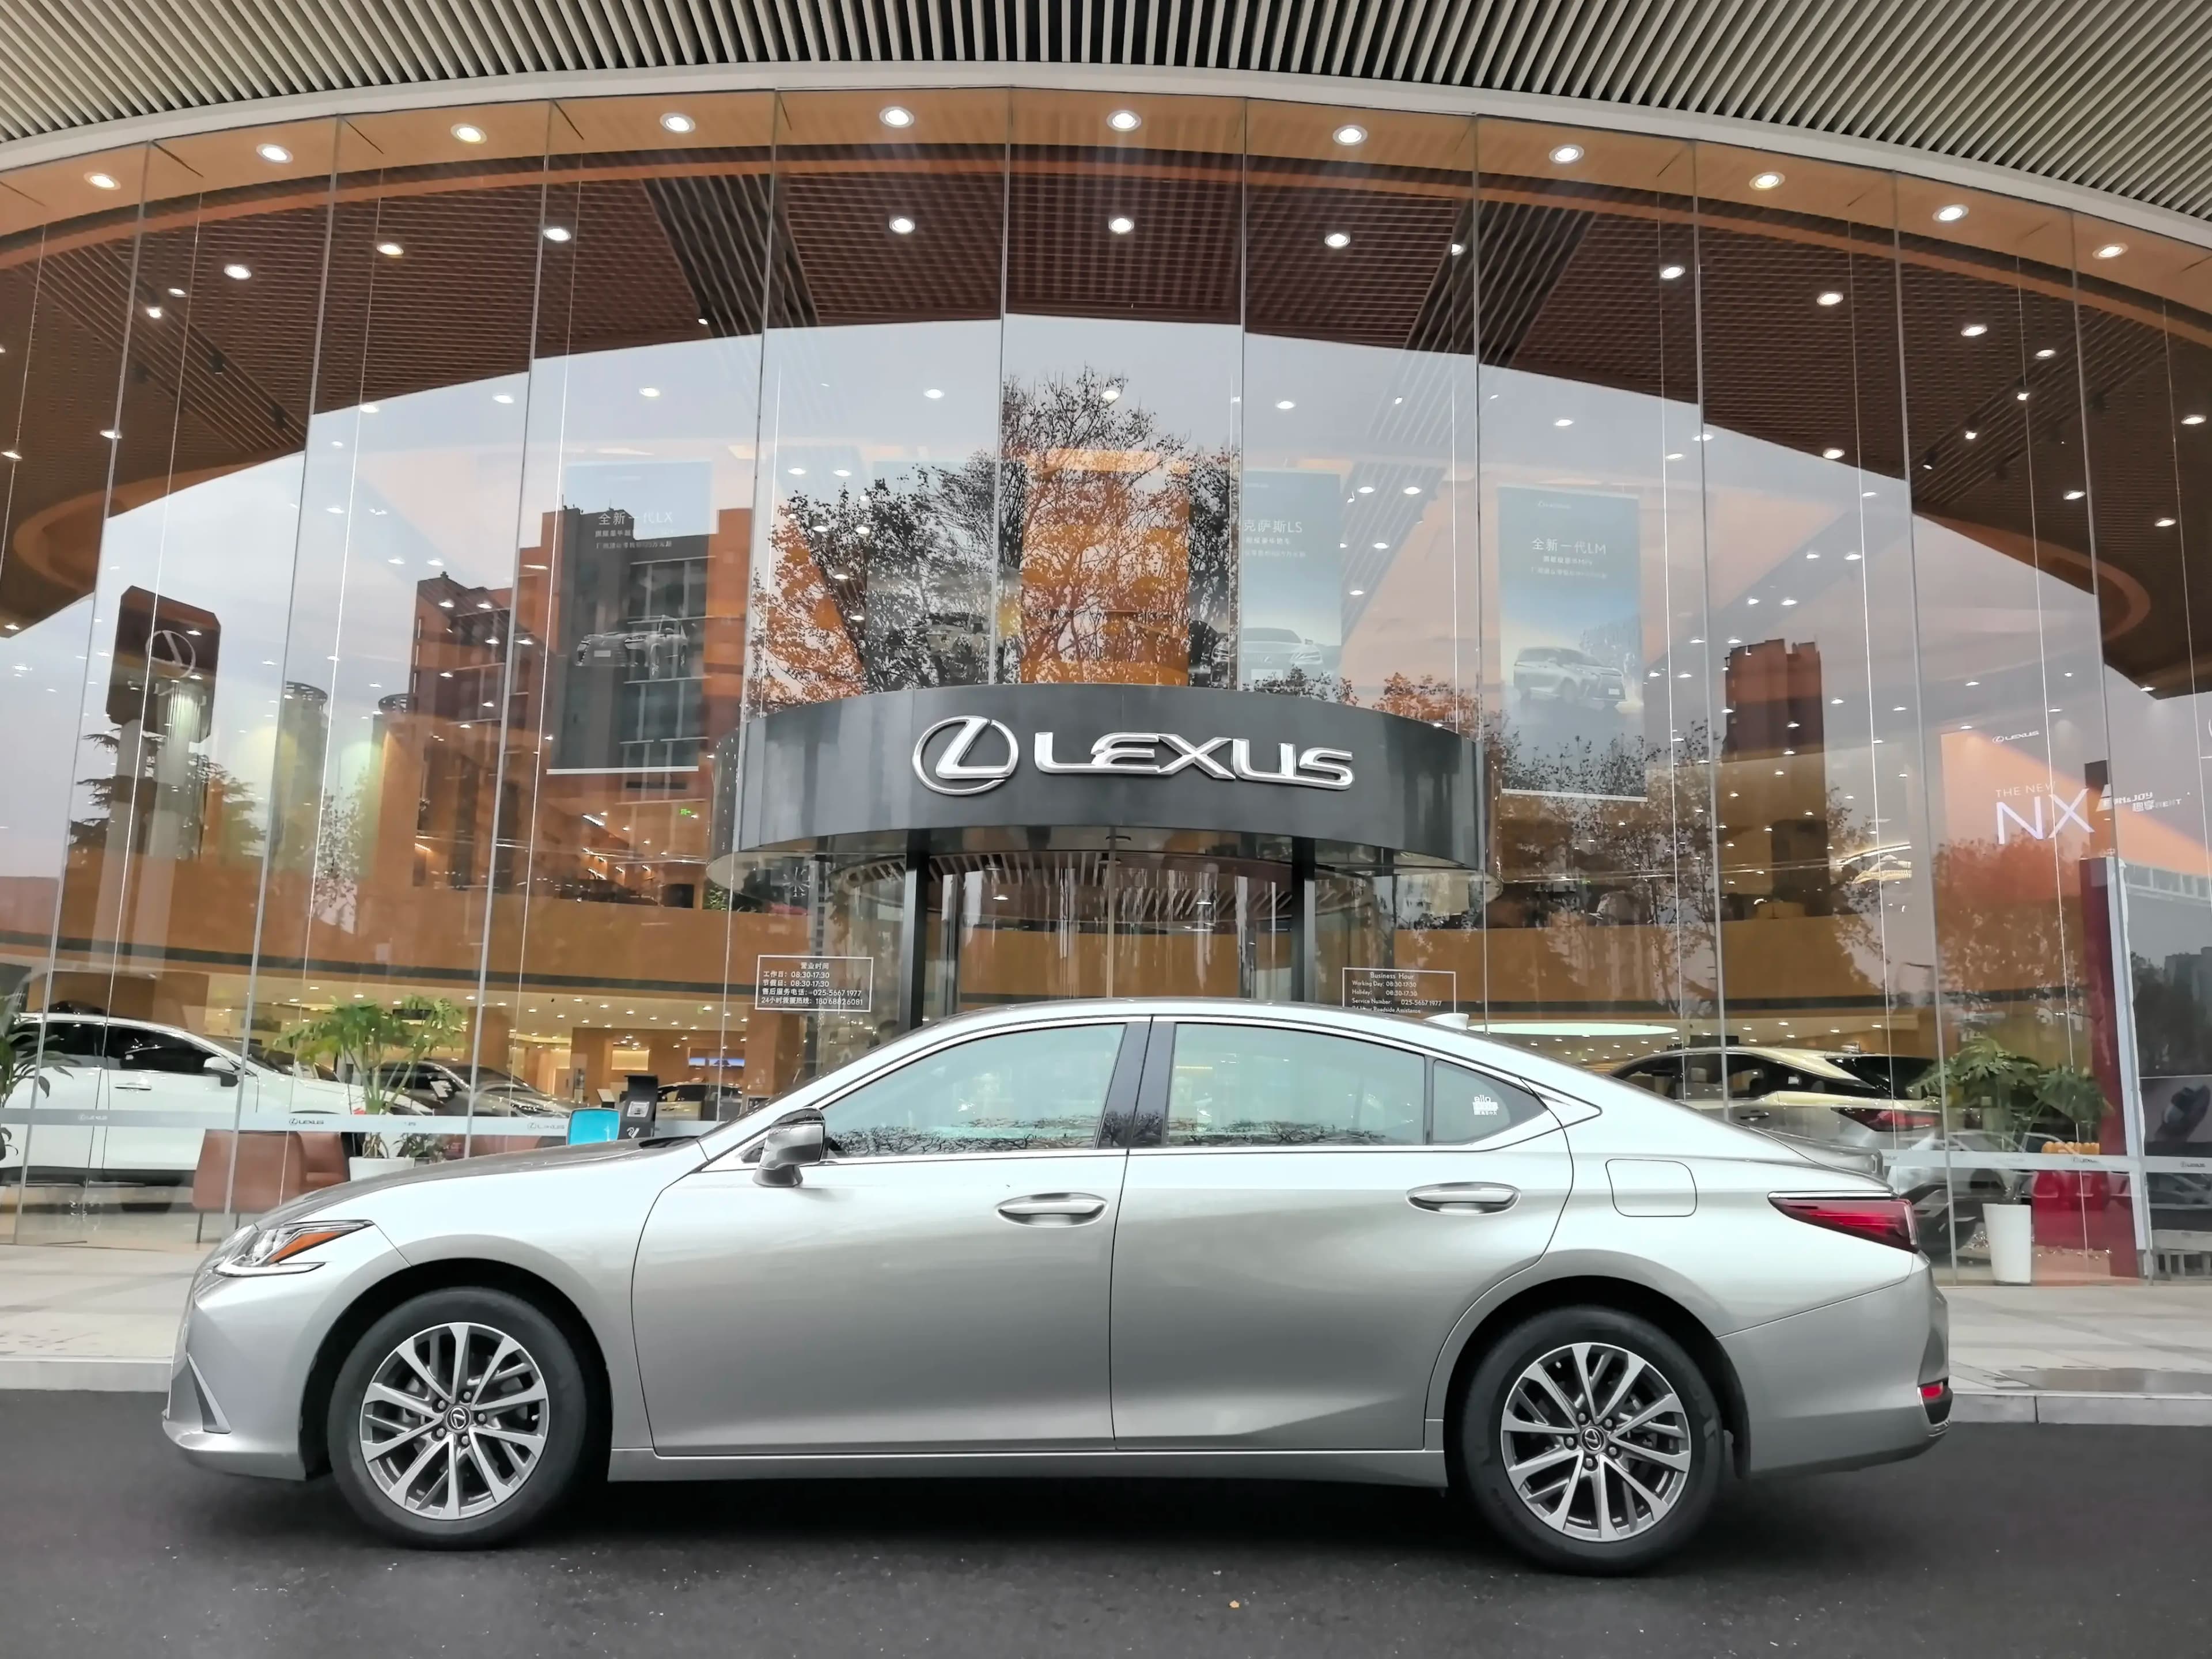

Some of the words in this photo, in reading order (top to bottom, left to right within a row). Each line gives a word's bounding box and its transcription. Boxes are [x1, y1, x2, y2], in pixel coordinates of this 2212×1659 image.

[1244, 519, 1303, 533] 克萨斯LS
[1531, 537, 1607, 555] 全新一代LM
[2005, 730, 2039, 741] LEXUS
[1034, 732, 1355, 791] LEXUS
[1995, 787, 2021, 798] THE
[2025, 781, 2056, 793] NEW
[1995, 788, 2096, 844] NX
[800, 962, 829, 970] 营业时间
